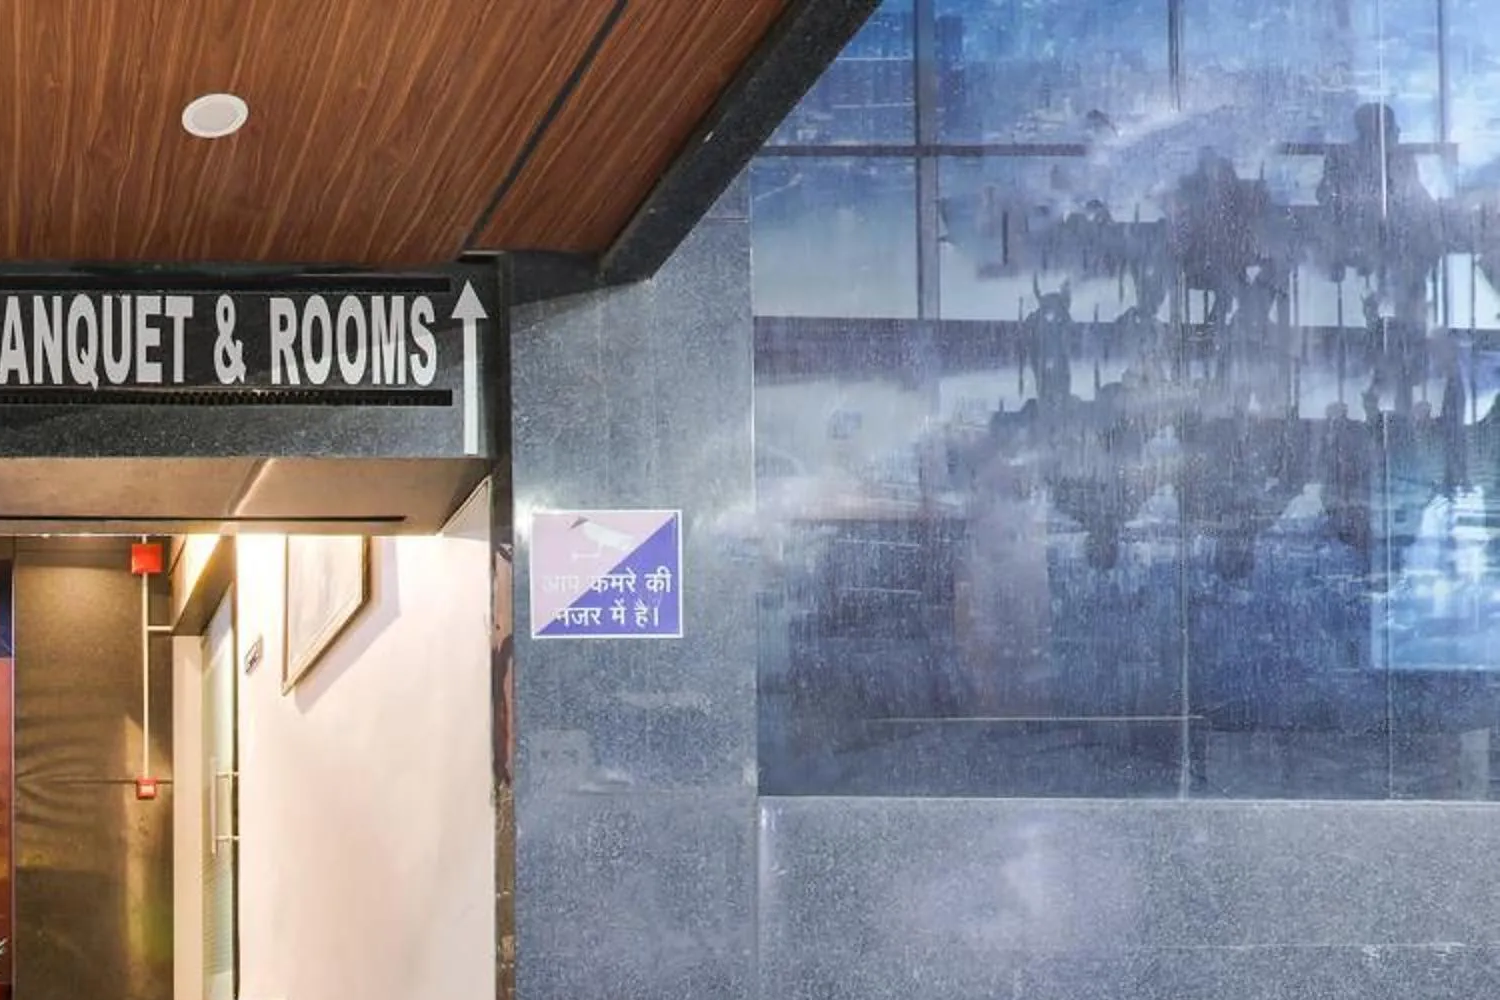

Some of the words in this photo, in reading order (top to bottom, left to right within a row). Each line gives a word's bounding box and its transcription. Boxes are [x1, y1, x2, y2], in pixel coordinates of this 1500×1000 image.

[213, 294, 247, 385] &
[269, 294, 437, 387] ROOMS
[645, 564, 672, 594] की
[609, 597, 627, 626] में
